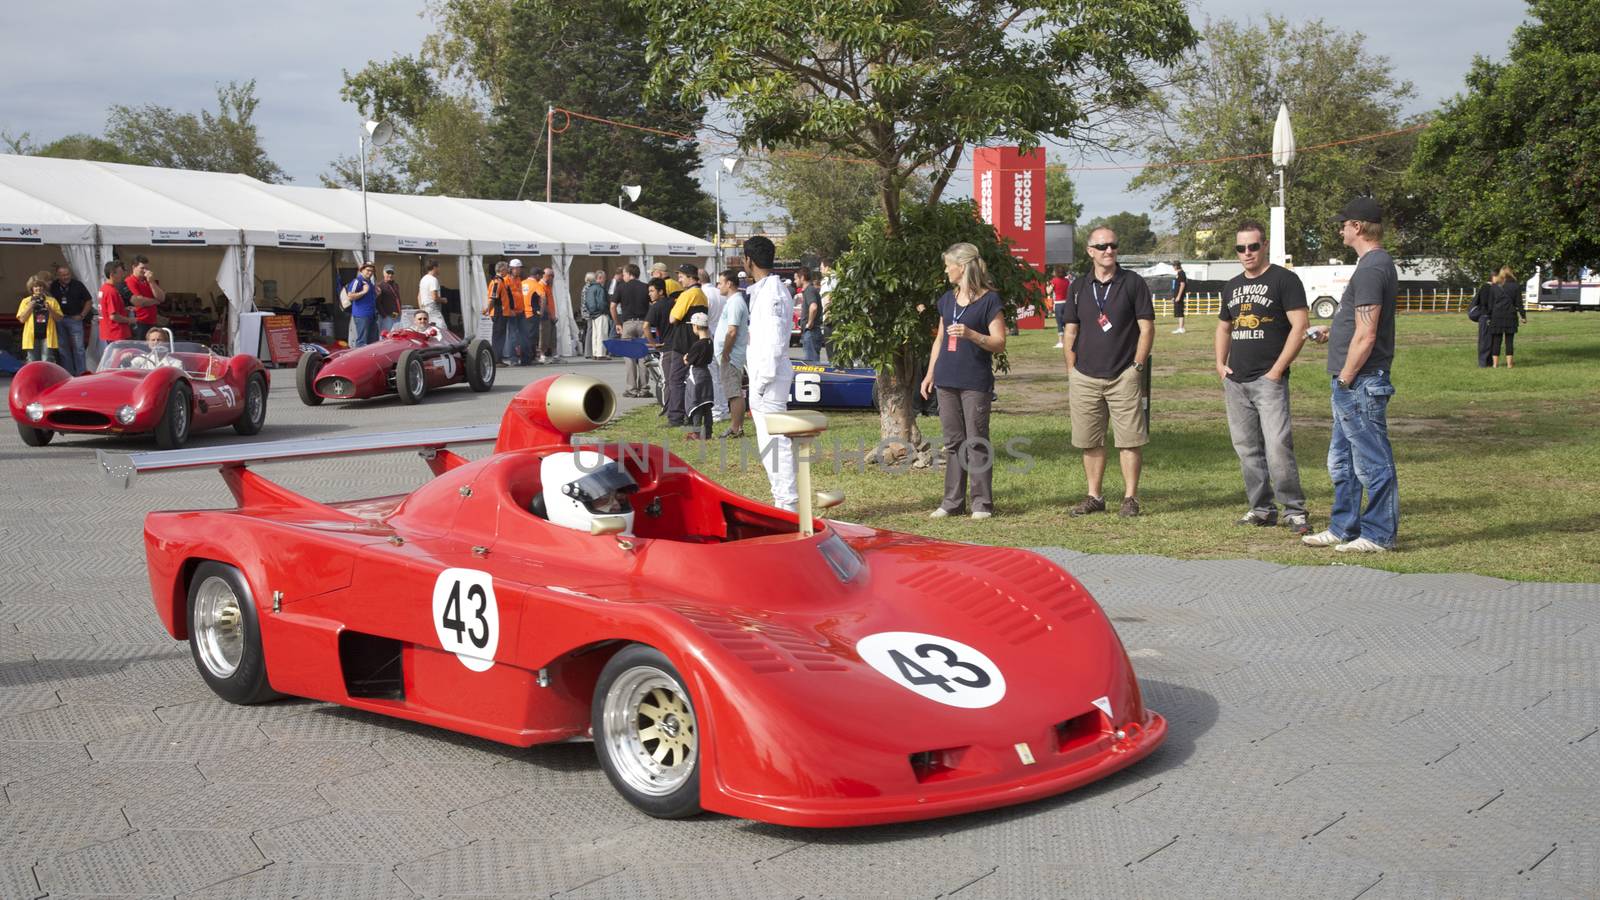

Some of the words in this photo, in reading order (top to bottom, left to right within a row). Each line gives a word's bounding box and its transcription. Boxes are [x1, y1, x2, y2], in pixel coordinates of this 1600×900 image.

[1014, 172, 1023, 227] SUPPORT
[1023, 170, 1032, 231] PADDOCK
[1233, 284, 1268, 298] ELWOOD
[443, 580, 489, 648] 43
[887, 643, 991, 693] 43
